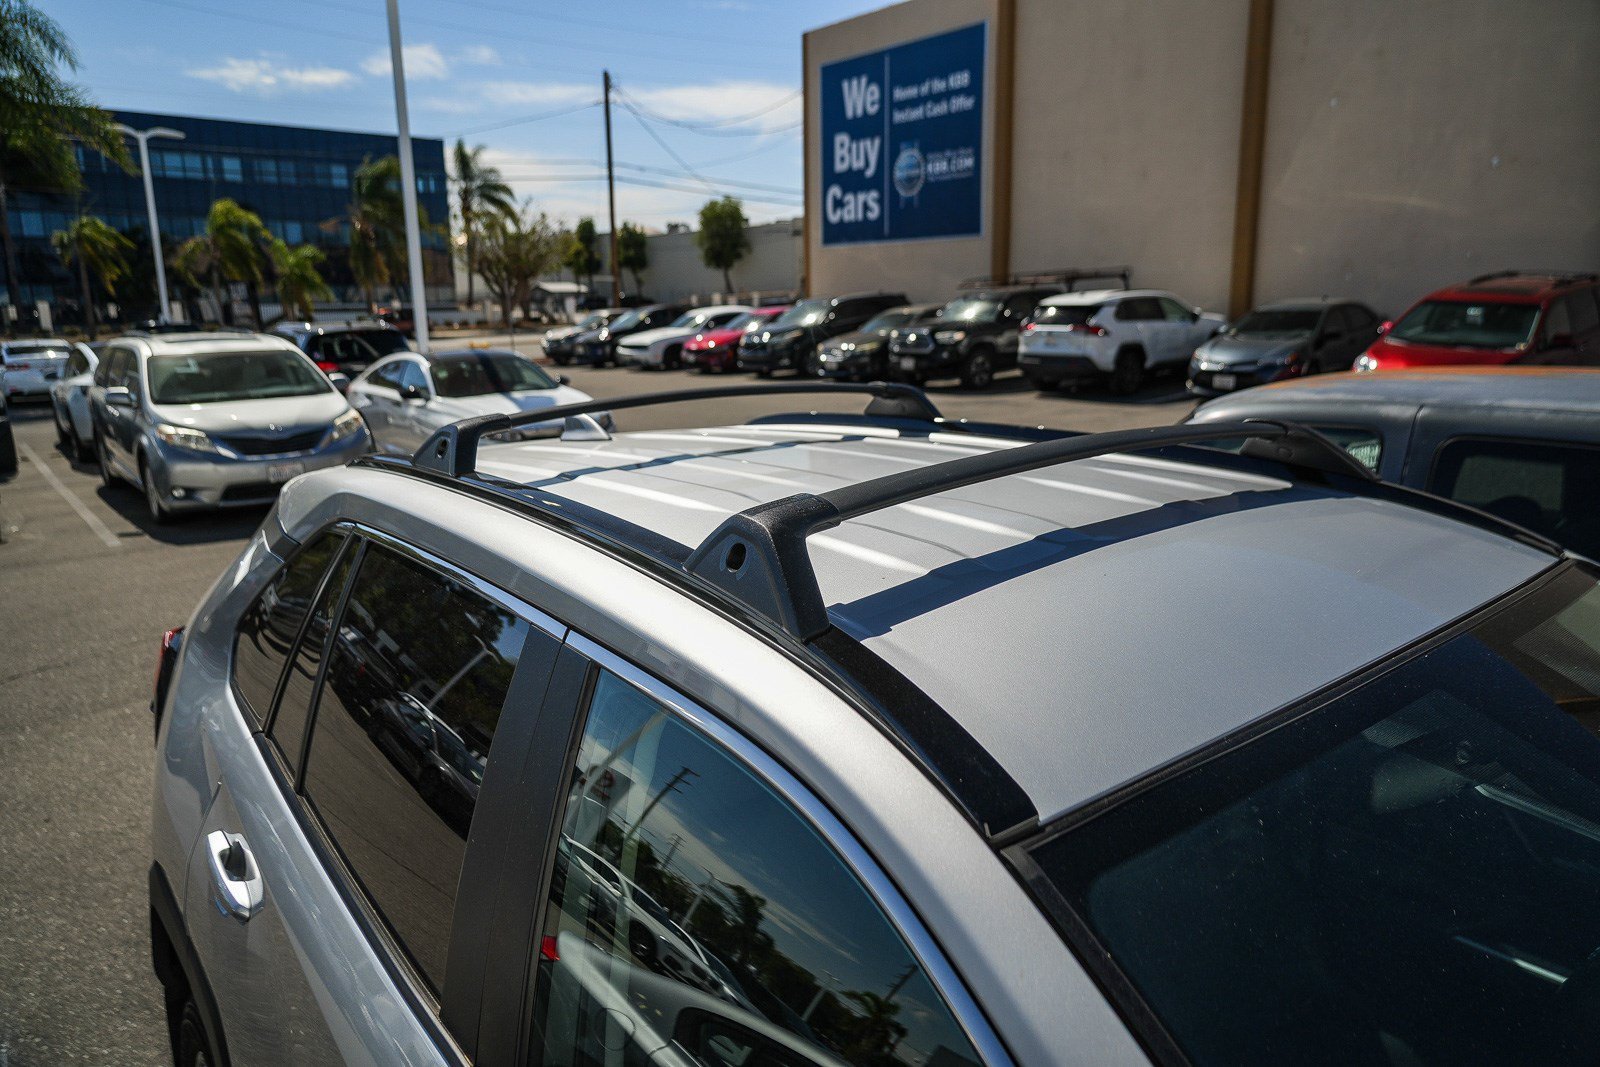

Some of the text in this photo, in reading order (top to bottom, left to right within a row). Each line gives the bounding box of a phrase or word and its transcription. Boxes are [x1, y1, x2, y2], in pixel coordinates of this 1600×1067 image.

[842, 75, 880, 120] We
[893, 85, 919, 101] Home
[920, 79, 932, 96] of
[933, 77, 948, 93] the
[949, 96, 976, 113] Offer
[833, 133, 881, 177] Buy
[826, 184, 880, 224] Cars
